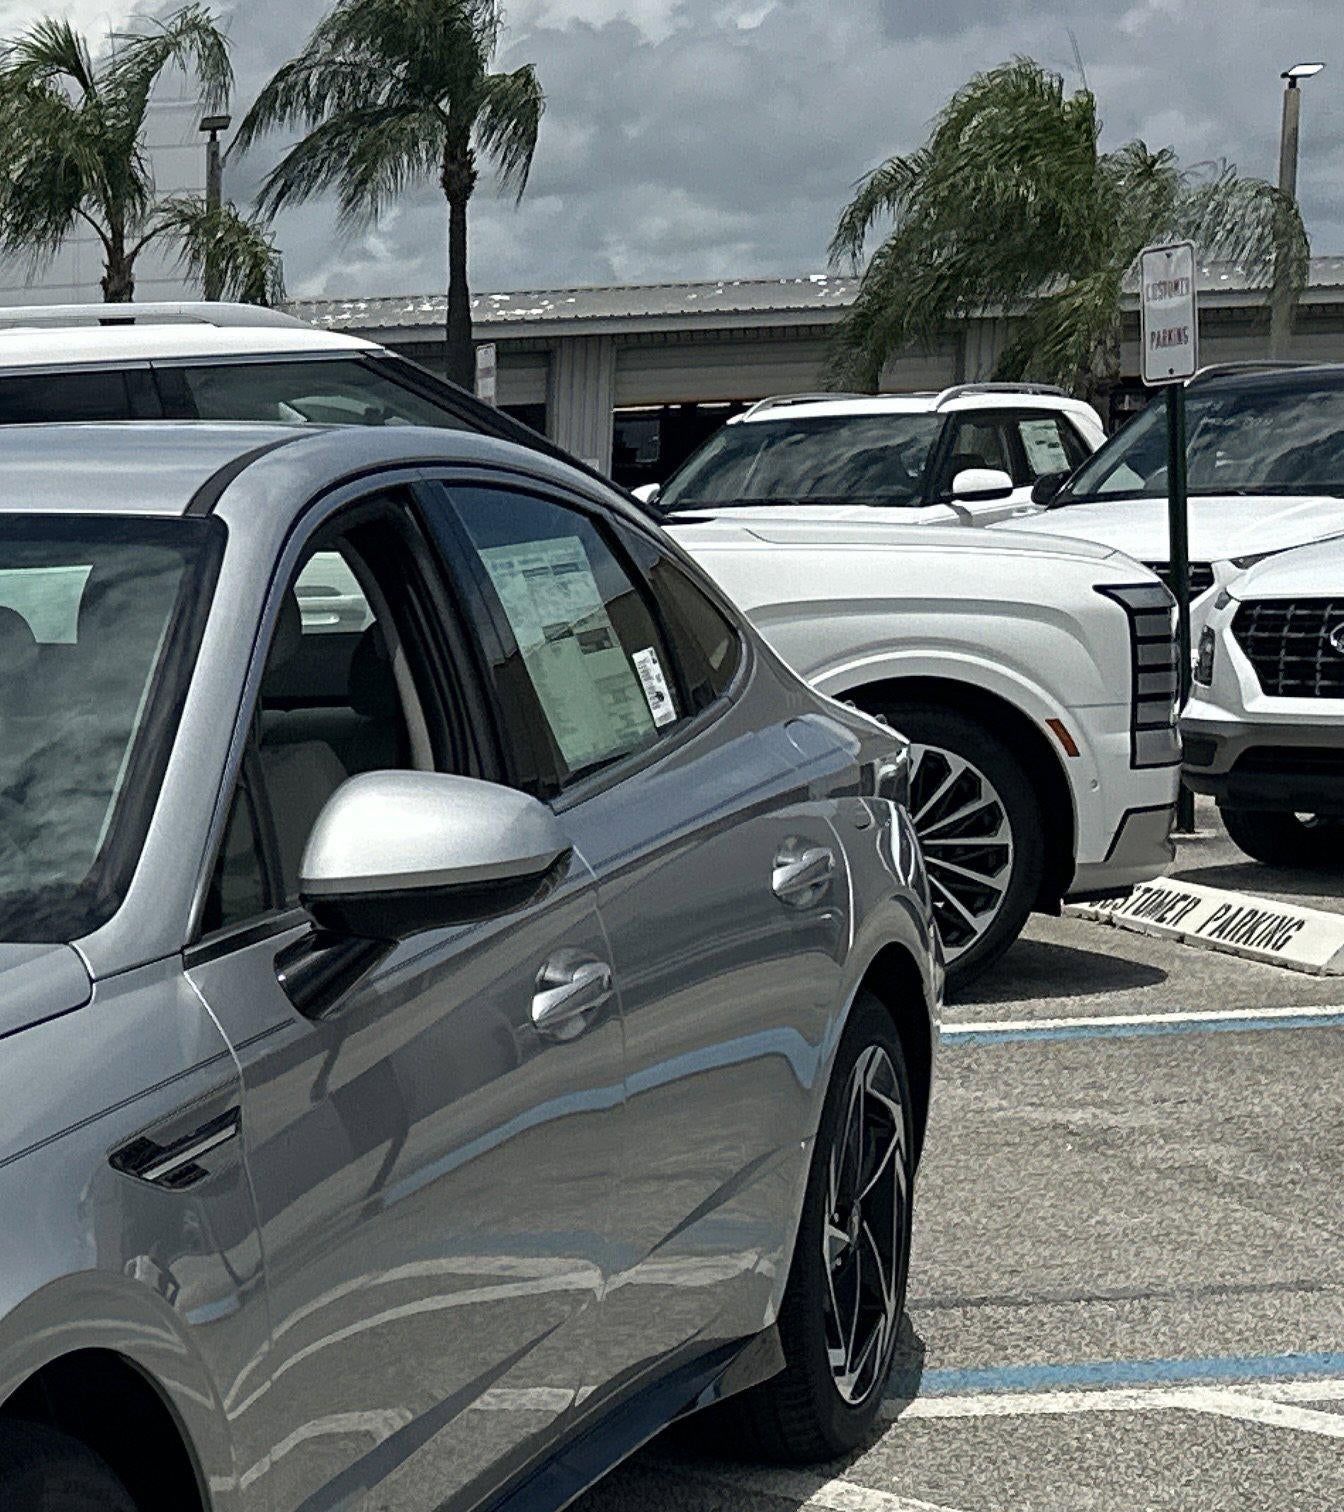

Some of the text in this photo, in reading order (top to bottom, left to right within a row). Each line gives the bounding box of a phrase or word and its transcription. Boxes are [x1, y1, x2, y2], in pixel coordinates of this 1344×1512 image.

[1150, 326, 1189, 351] PARKING
[1088, 886, 1306, 952] STOMER PARKING
